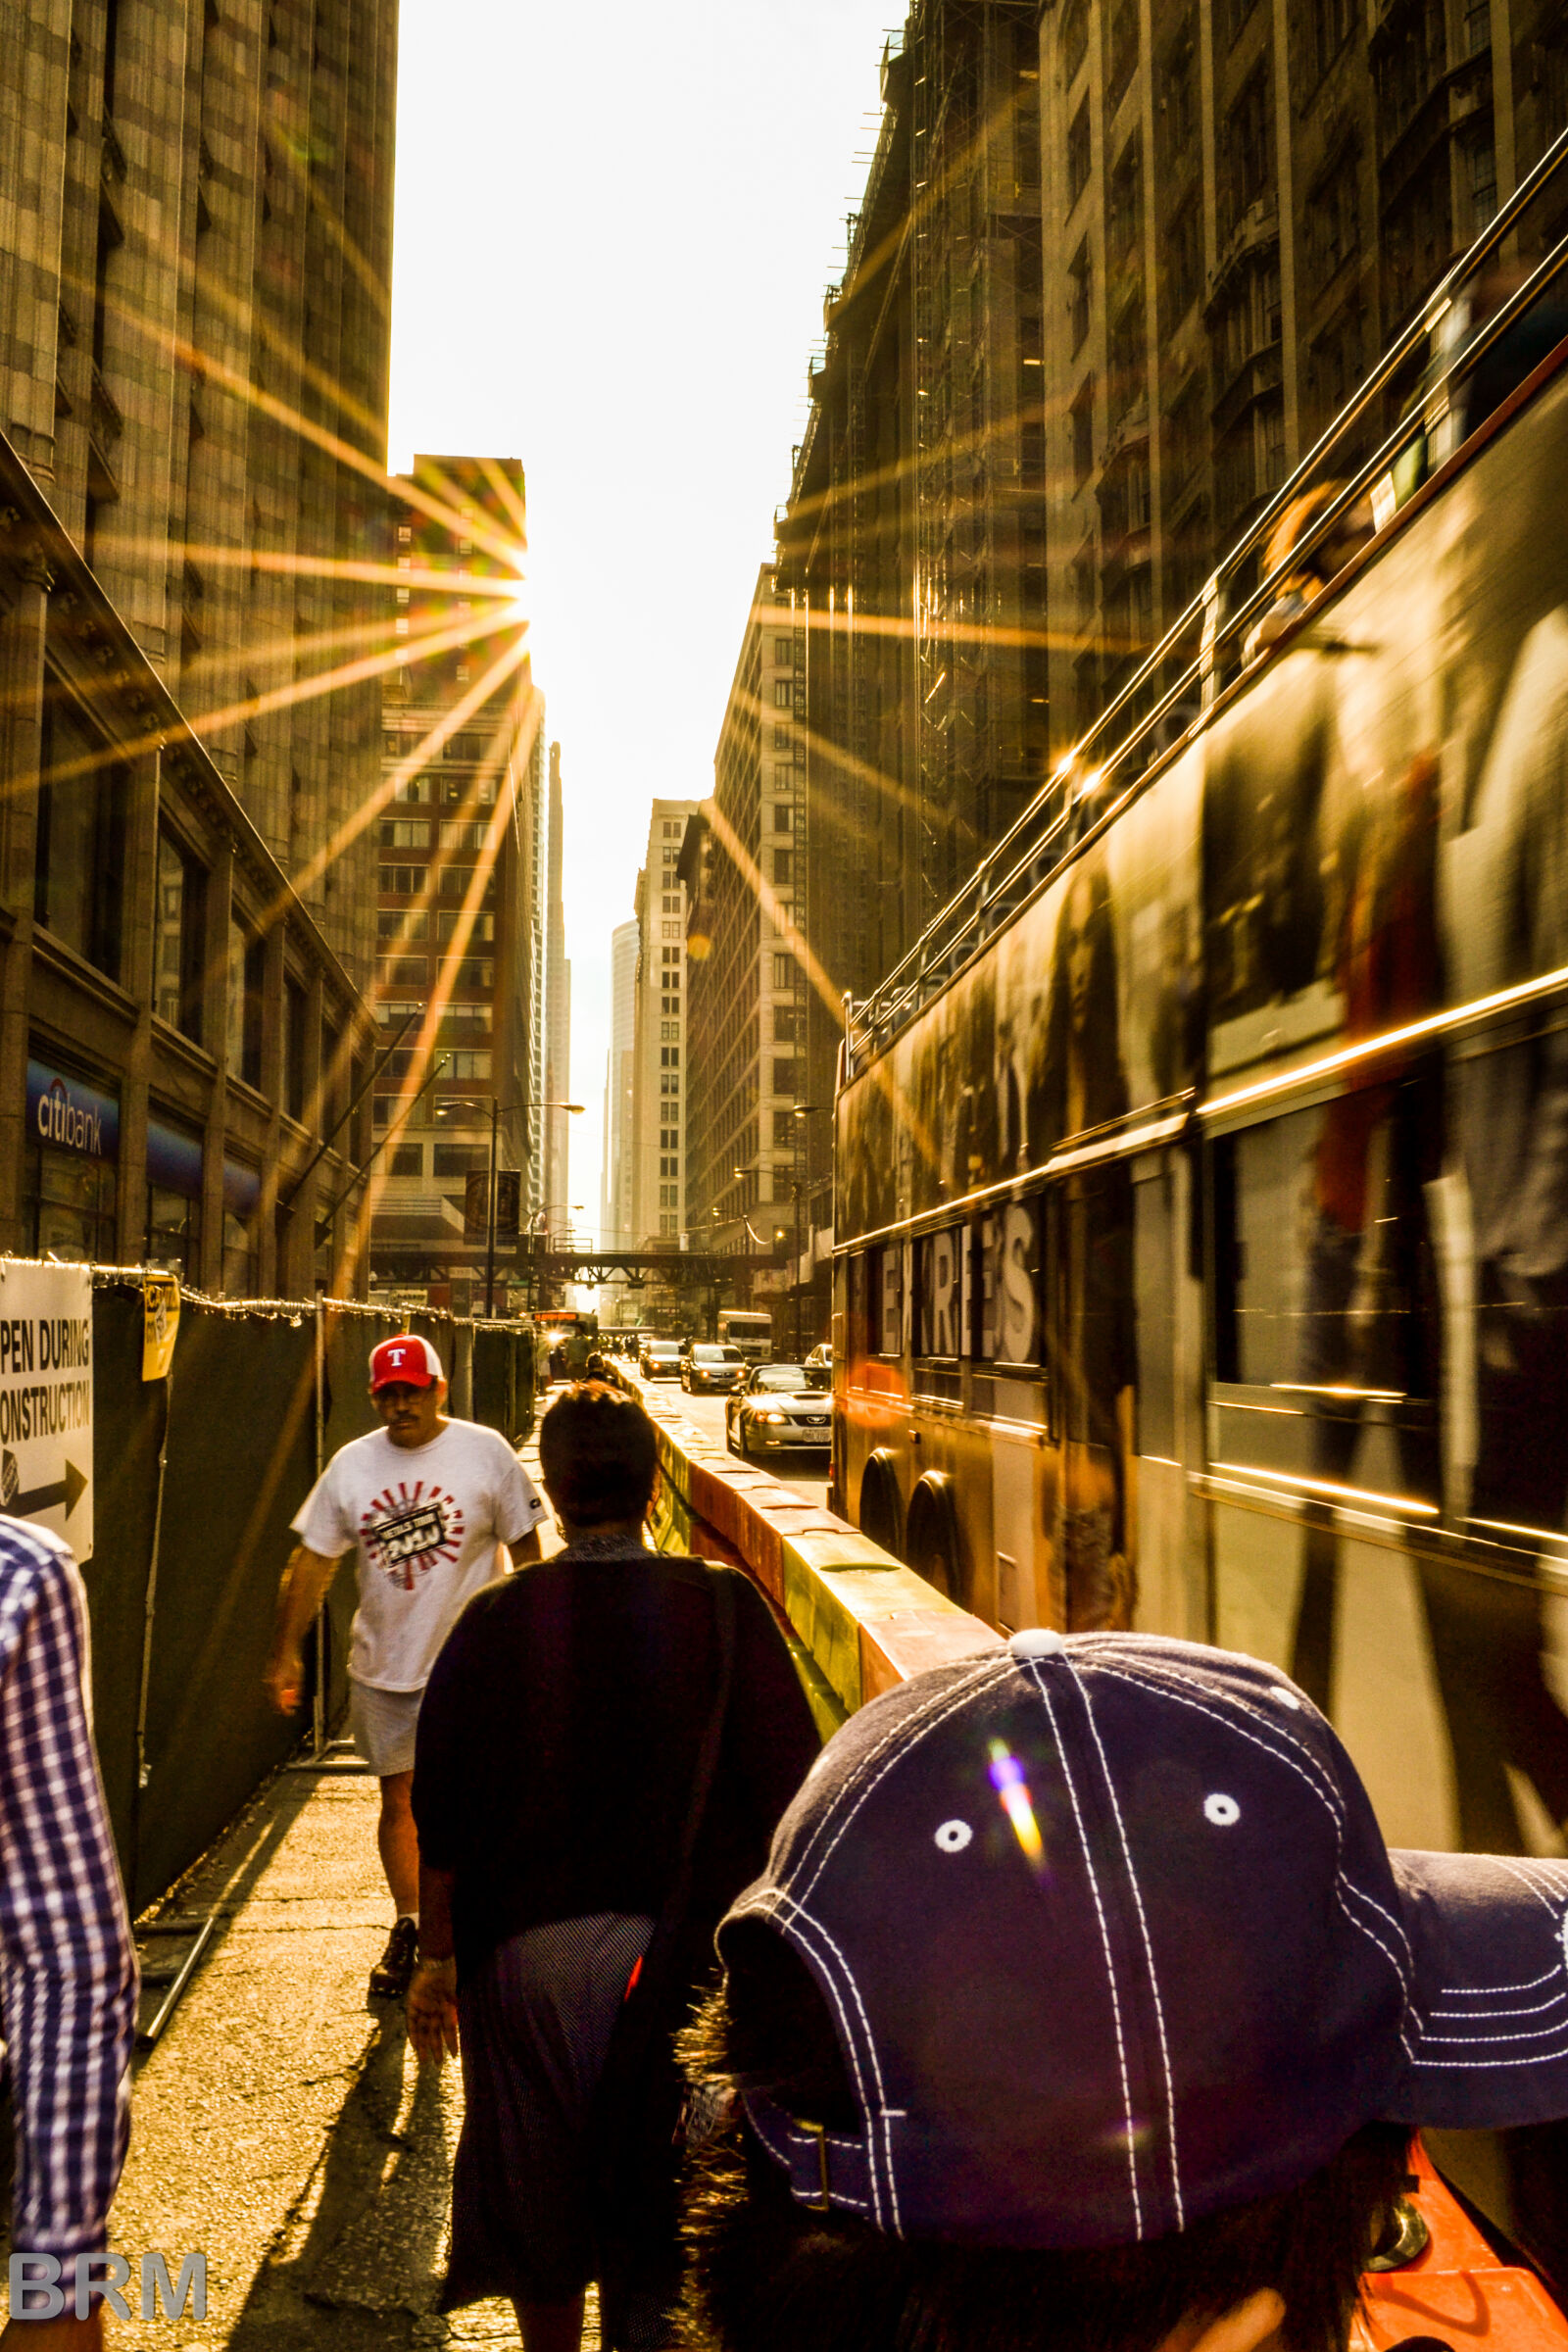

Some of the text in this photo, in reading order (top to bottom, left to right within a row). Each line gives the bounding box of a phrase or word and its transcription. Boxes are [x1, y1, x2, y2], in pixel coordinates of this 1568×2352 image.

[37, 1087, 102, 1155] citibank
[39, 1318, 89, 1371] DURING
[387, 1348, 407, 1367] T
